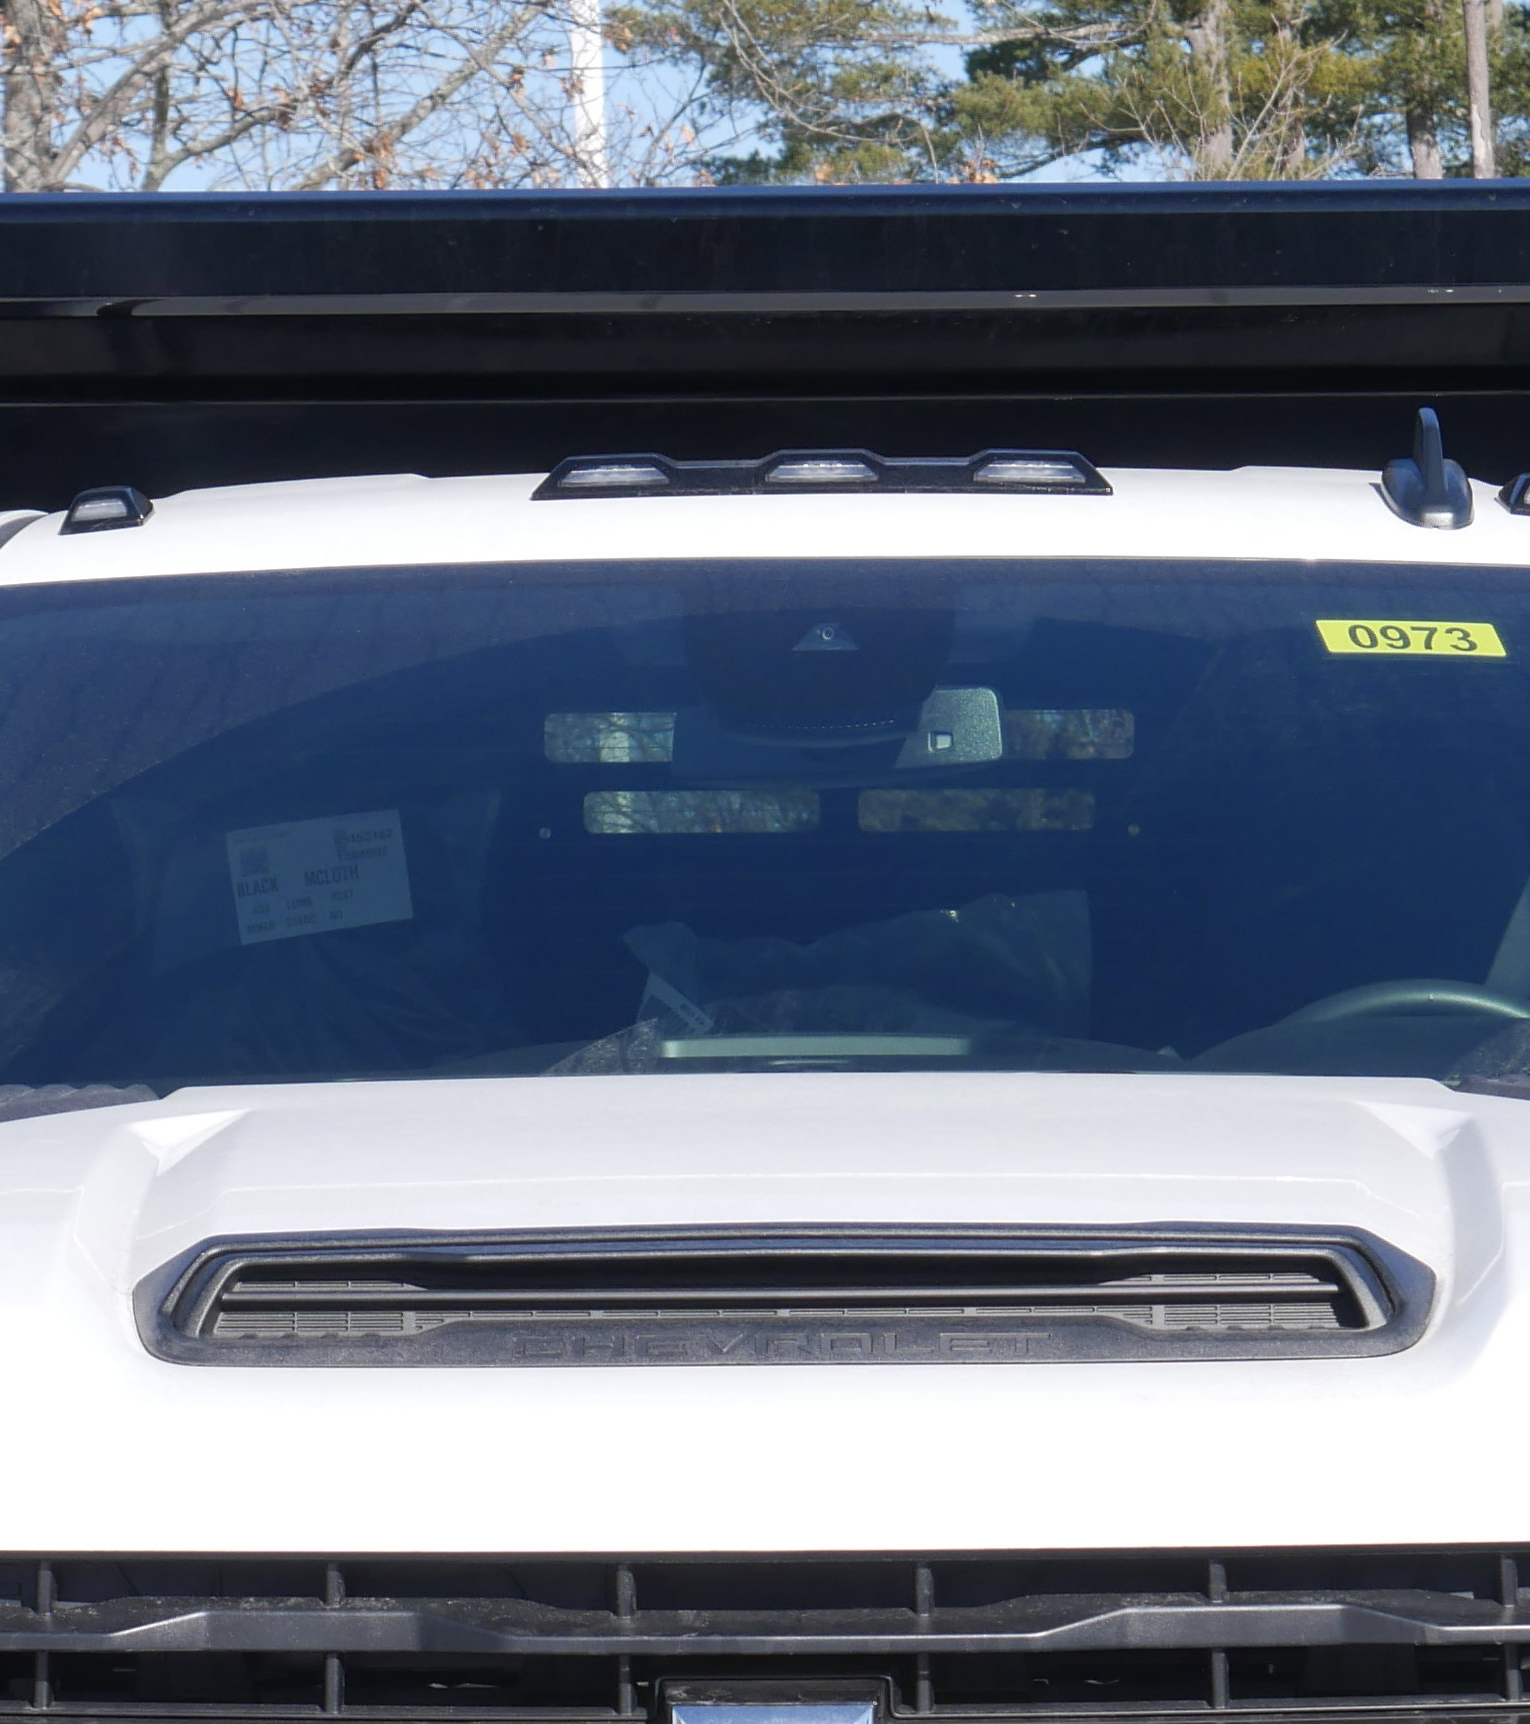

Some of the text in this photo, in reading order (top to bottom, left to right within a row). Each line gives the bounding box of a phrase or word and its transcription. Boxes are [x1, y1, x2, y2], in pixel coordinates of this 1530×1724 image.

[1347, 623, 1478, 653] 0973
[236, 877, 280, 899] BLACK
[511, 1331, 1052, 1357] CHEVROLET
